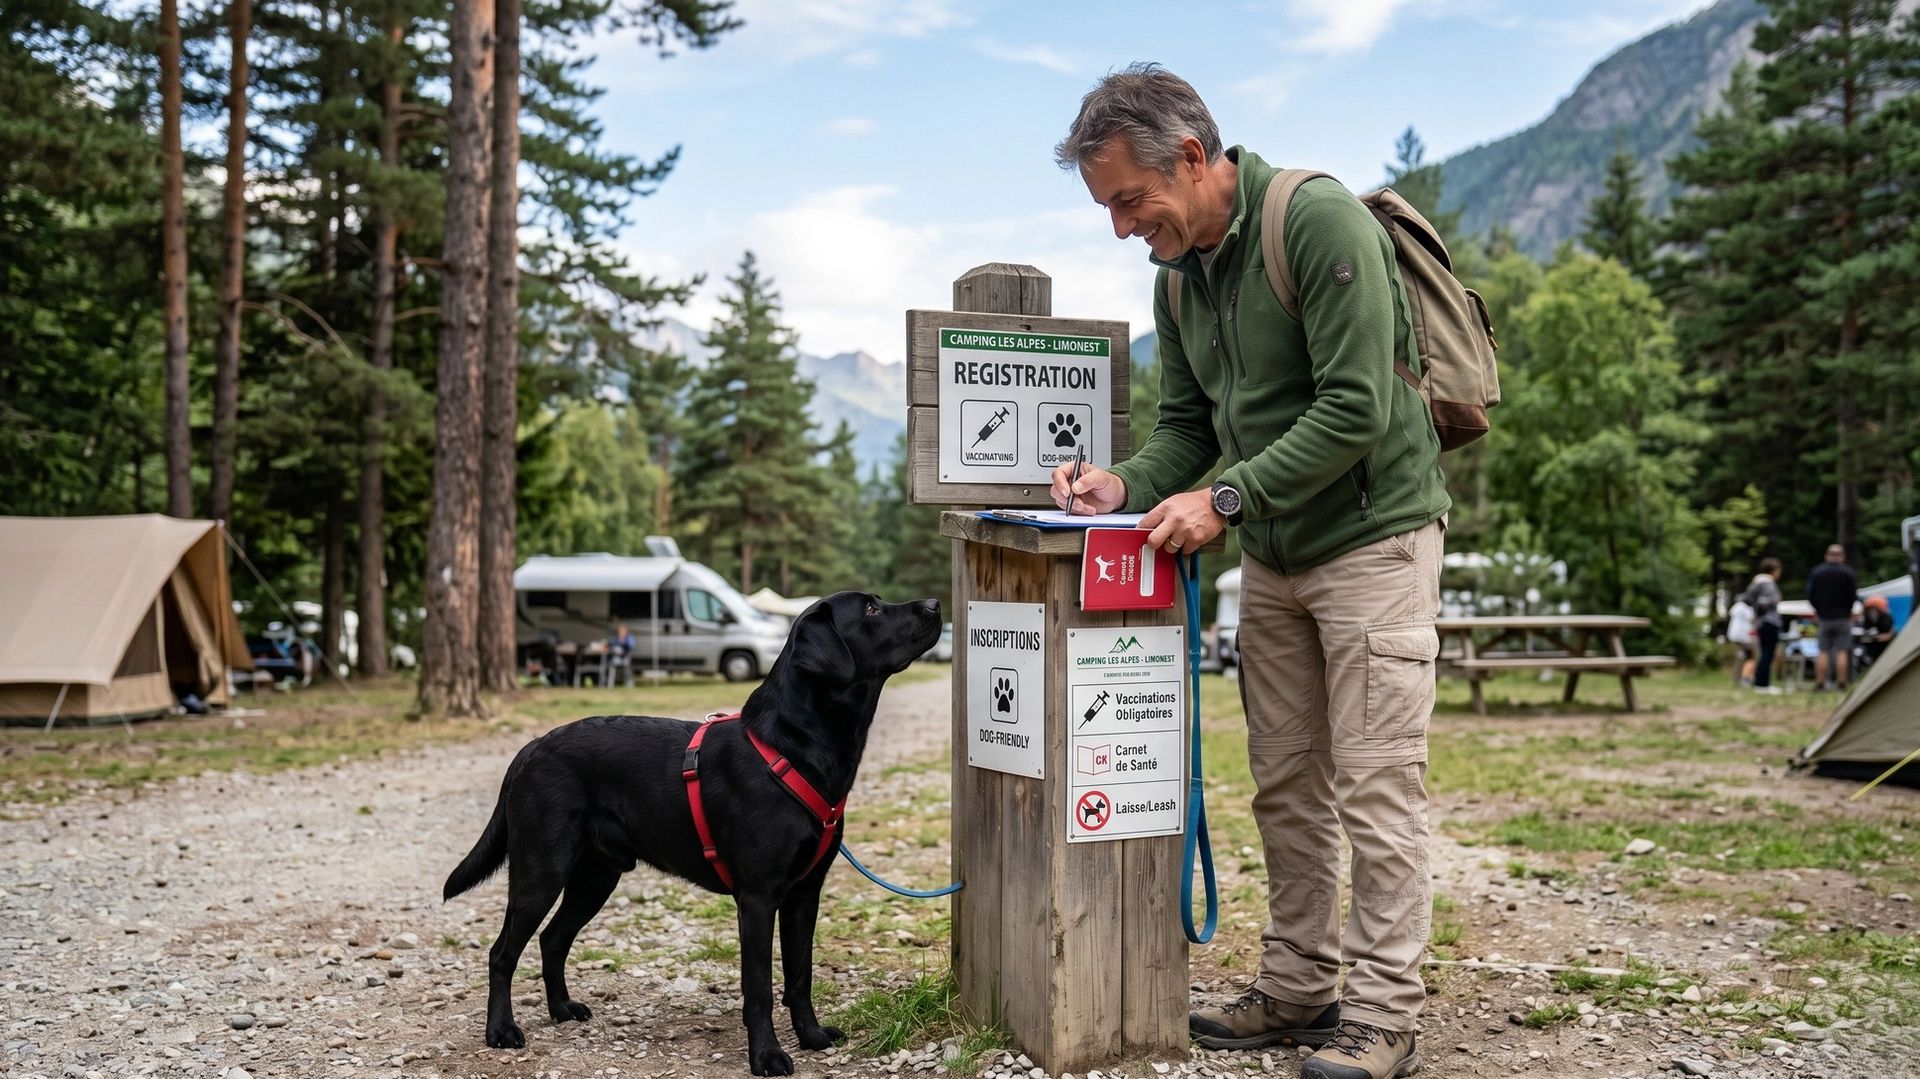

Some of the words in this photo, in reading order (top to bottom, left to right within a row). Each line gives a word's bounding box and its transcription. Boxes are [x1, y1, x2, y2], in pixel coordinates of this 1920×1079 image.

[950, 333, 996, 347] CAMPING
[998, 336, 1015, 348] LES
[1016, 337, 1046, 350] ALPES
[1053, 340, 1100, 353] LIMONEST
[954, 361, 1096, 390] REGISTRATION
[970, 628, 1040, 651] INSCRIPTIONS
[1077, 656, 1107, 665] CAMPING
[1108, 656, 1119, 664] LES
[1120, 655, 1140, 664] ALPES
[1145, 654, 1175, 663] LIMONEST
[1115, 691, 1176, 705] Vaccinations
[1115, 707, 1173, 722] Obligatoires
[979, 728, 1030, 750] DOG-FRIENDLY
[1115, 744, 1148, 756] Carnet
[1095, 755, 1108, 765] CK
[1115, 760, 1128, 772] de
[1130, 757, 1158, 771] Santé
[1115, 799, 1176, 814] Laisse/Leash
